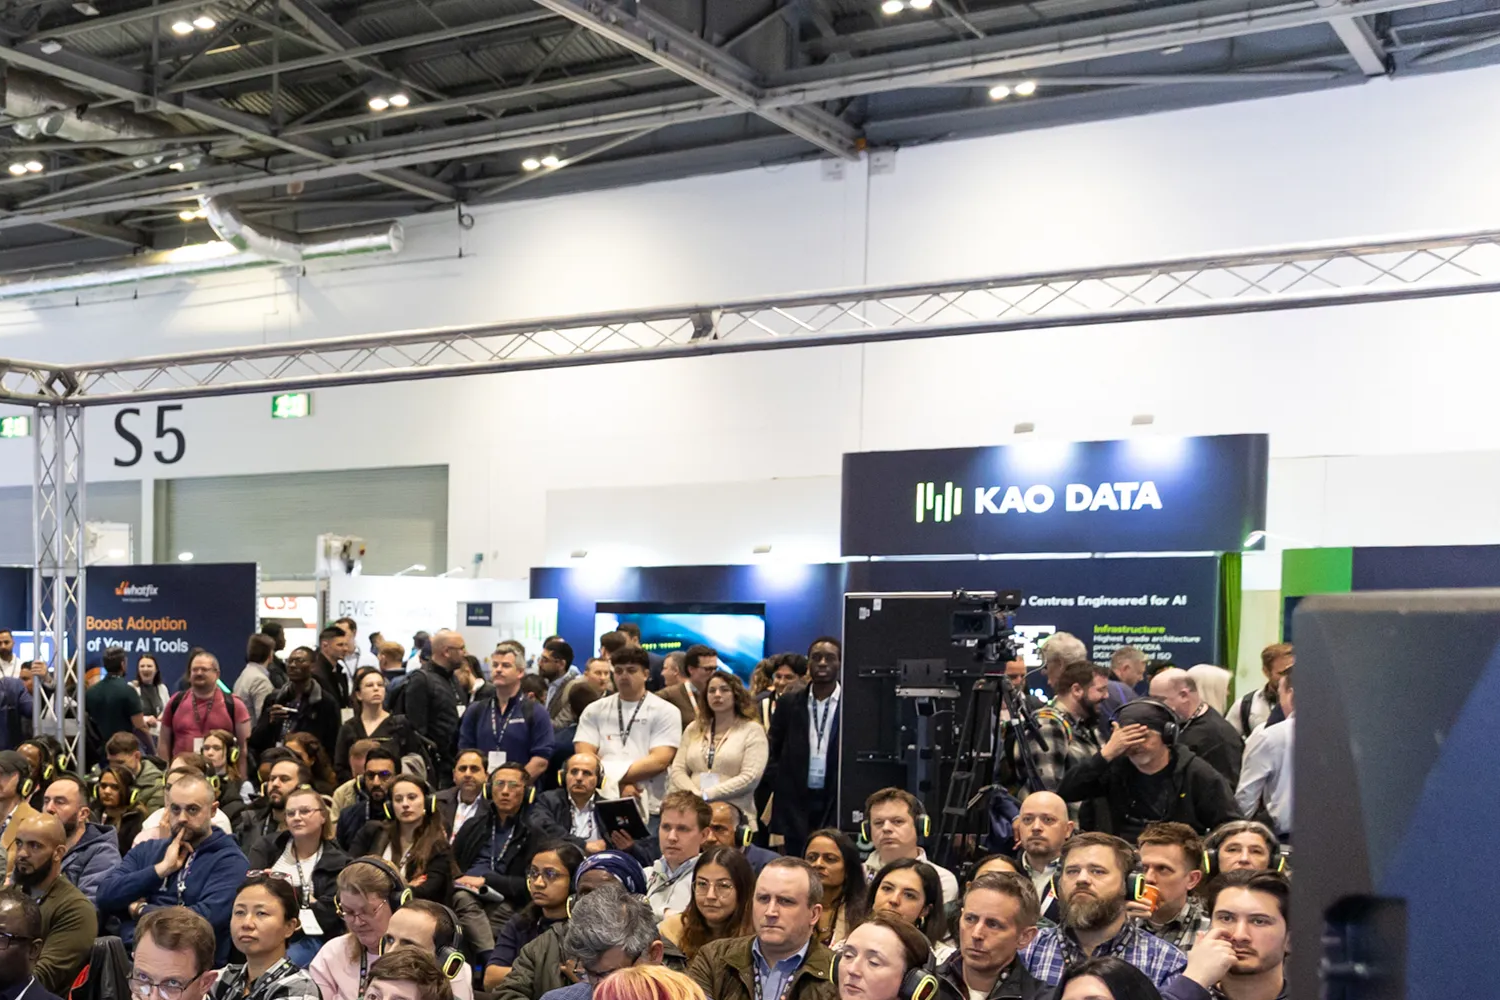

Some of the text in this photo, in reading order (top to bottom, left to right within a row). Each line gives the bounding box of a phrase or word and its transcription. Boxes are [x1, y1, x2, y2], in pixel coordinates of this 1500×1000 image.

[113, 404, 186, 467] S5
[975, 481, 1163, 515] KAO DATA
[1028, 595, 1187, 608] Centres Engineered for AI
[86, 616, 187, 634] Boost Adoption
[1093, 624, 1166, 634] Infrastructure
[87, 637, 189, 653] of Your AI Tools
[1093, 635, 1124, 644] Highest
[1151, 635, 1201, 643] architecture
